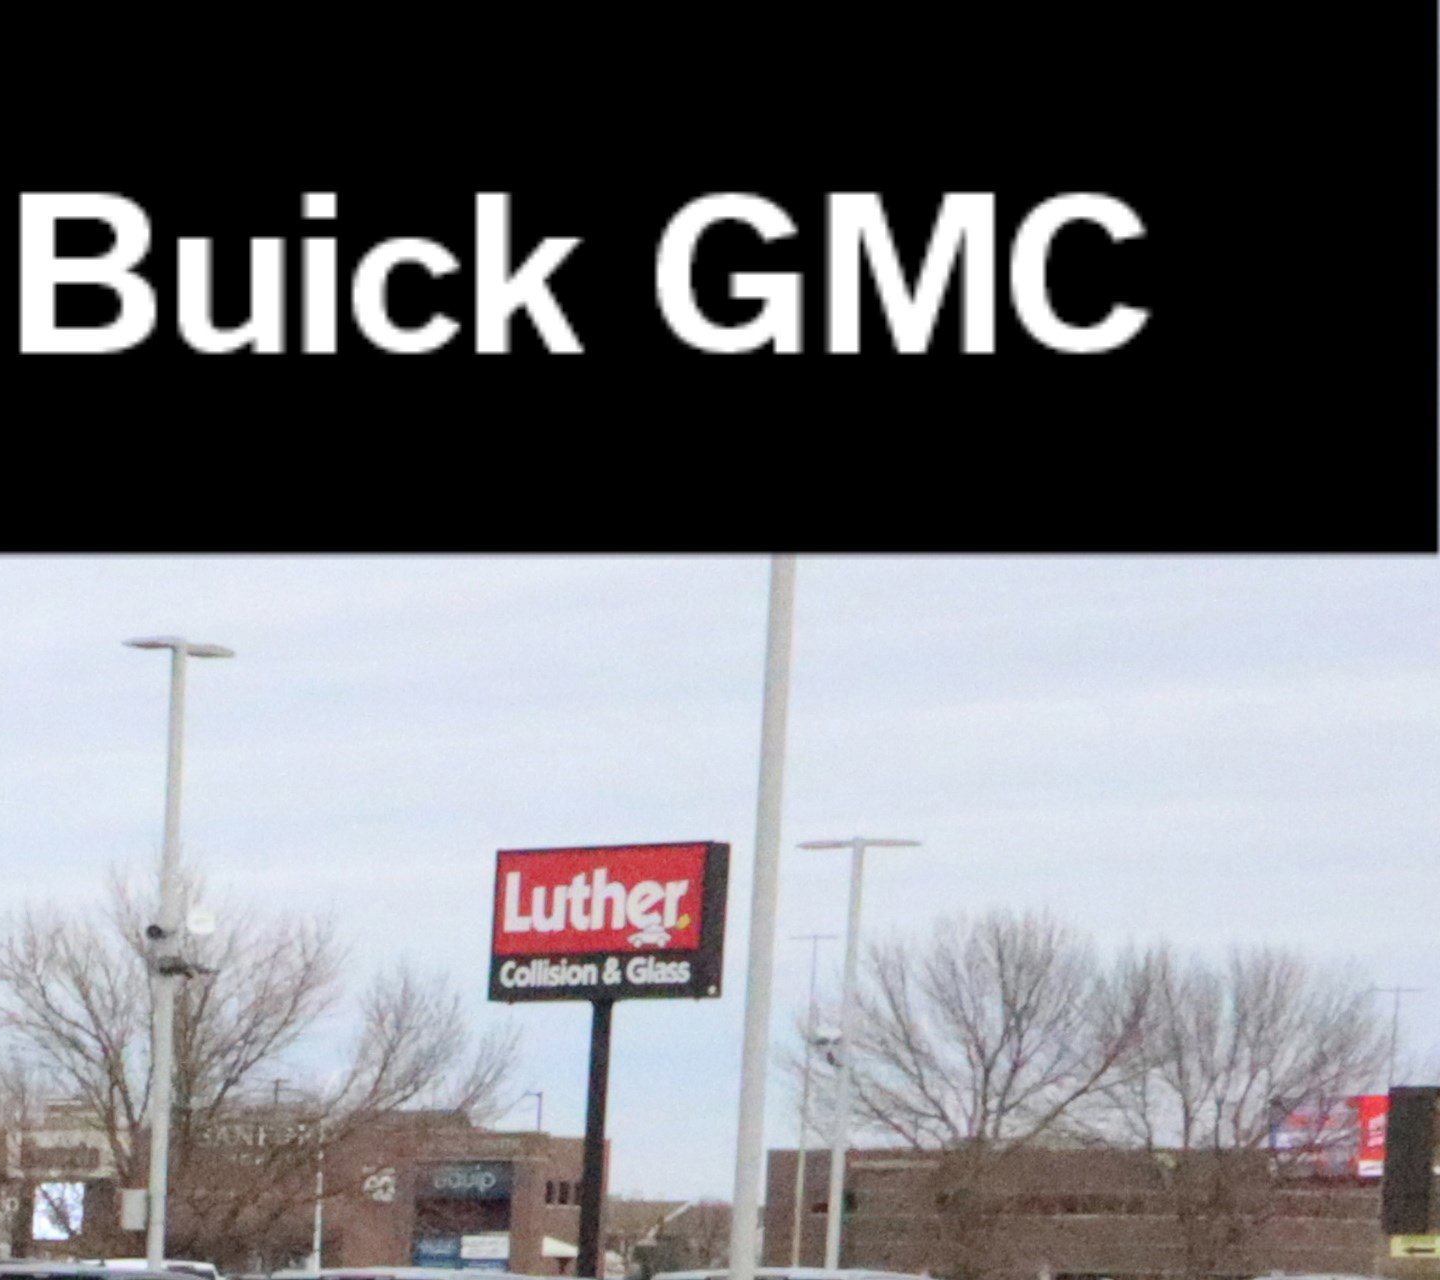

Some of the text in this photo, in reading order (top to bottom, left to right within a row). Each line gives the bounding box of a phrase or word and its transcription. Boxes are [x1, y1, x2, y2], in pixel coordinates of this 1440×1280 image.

[503, 867, 690, 933] Luther
[499, 954, 691, 989] Collision & Glass
